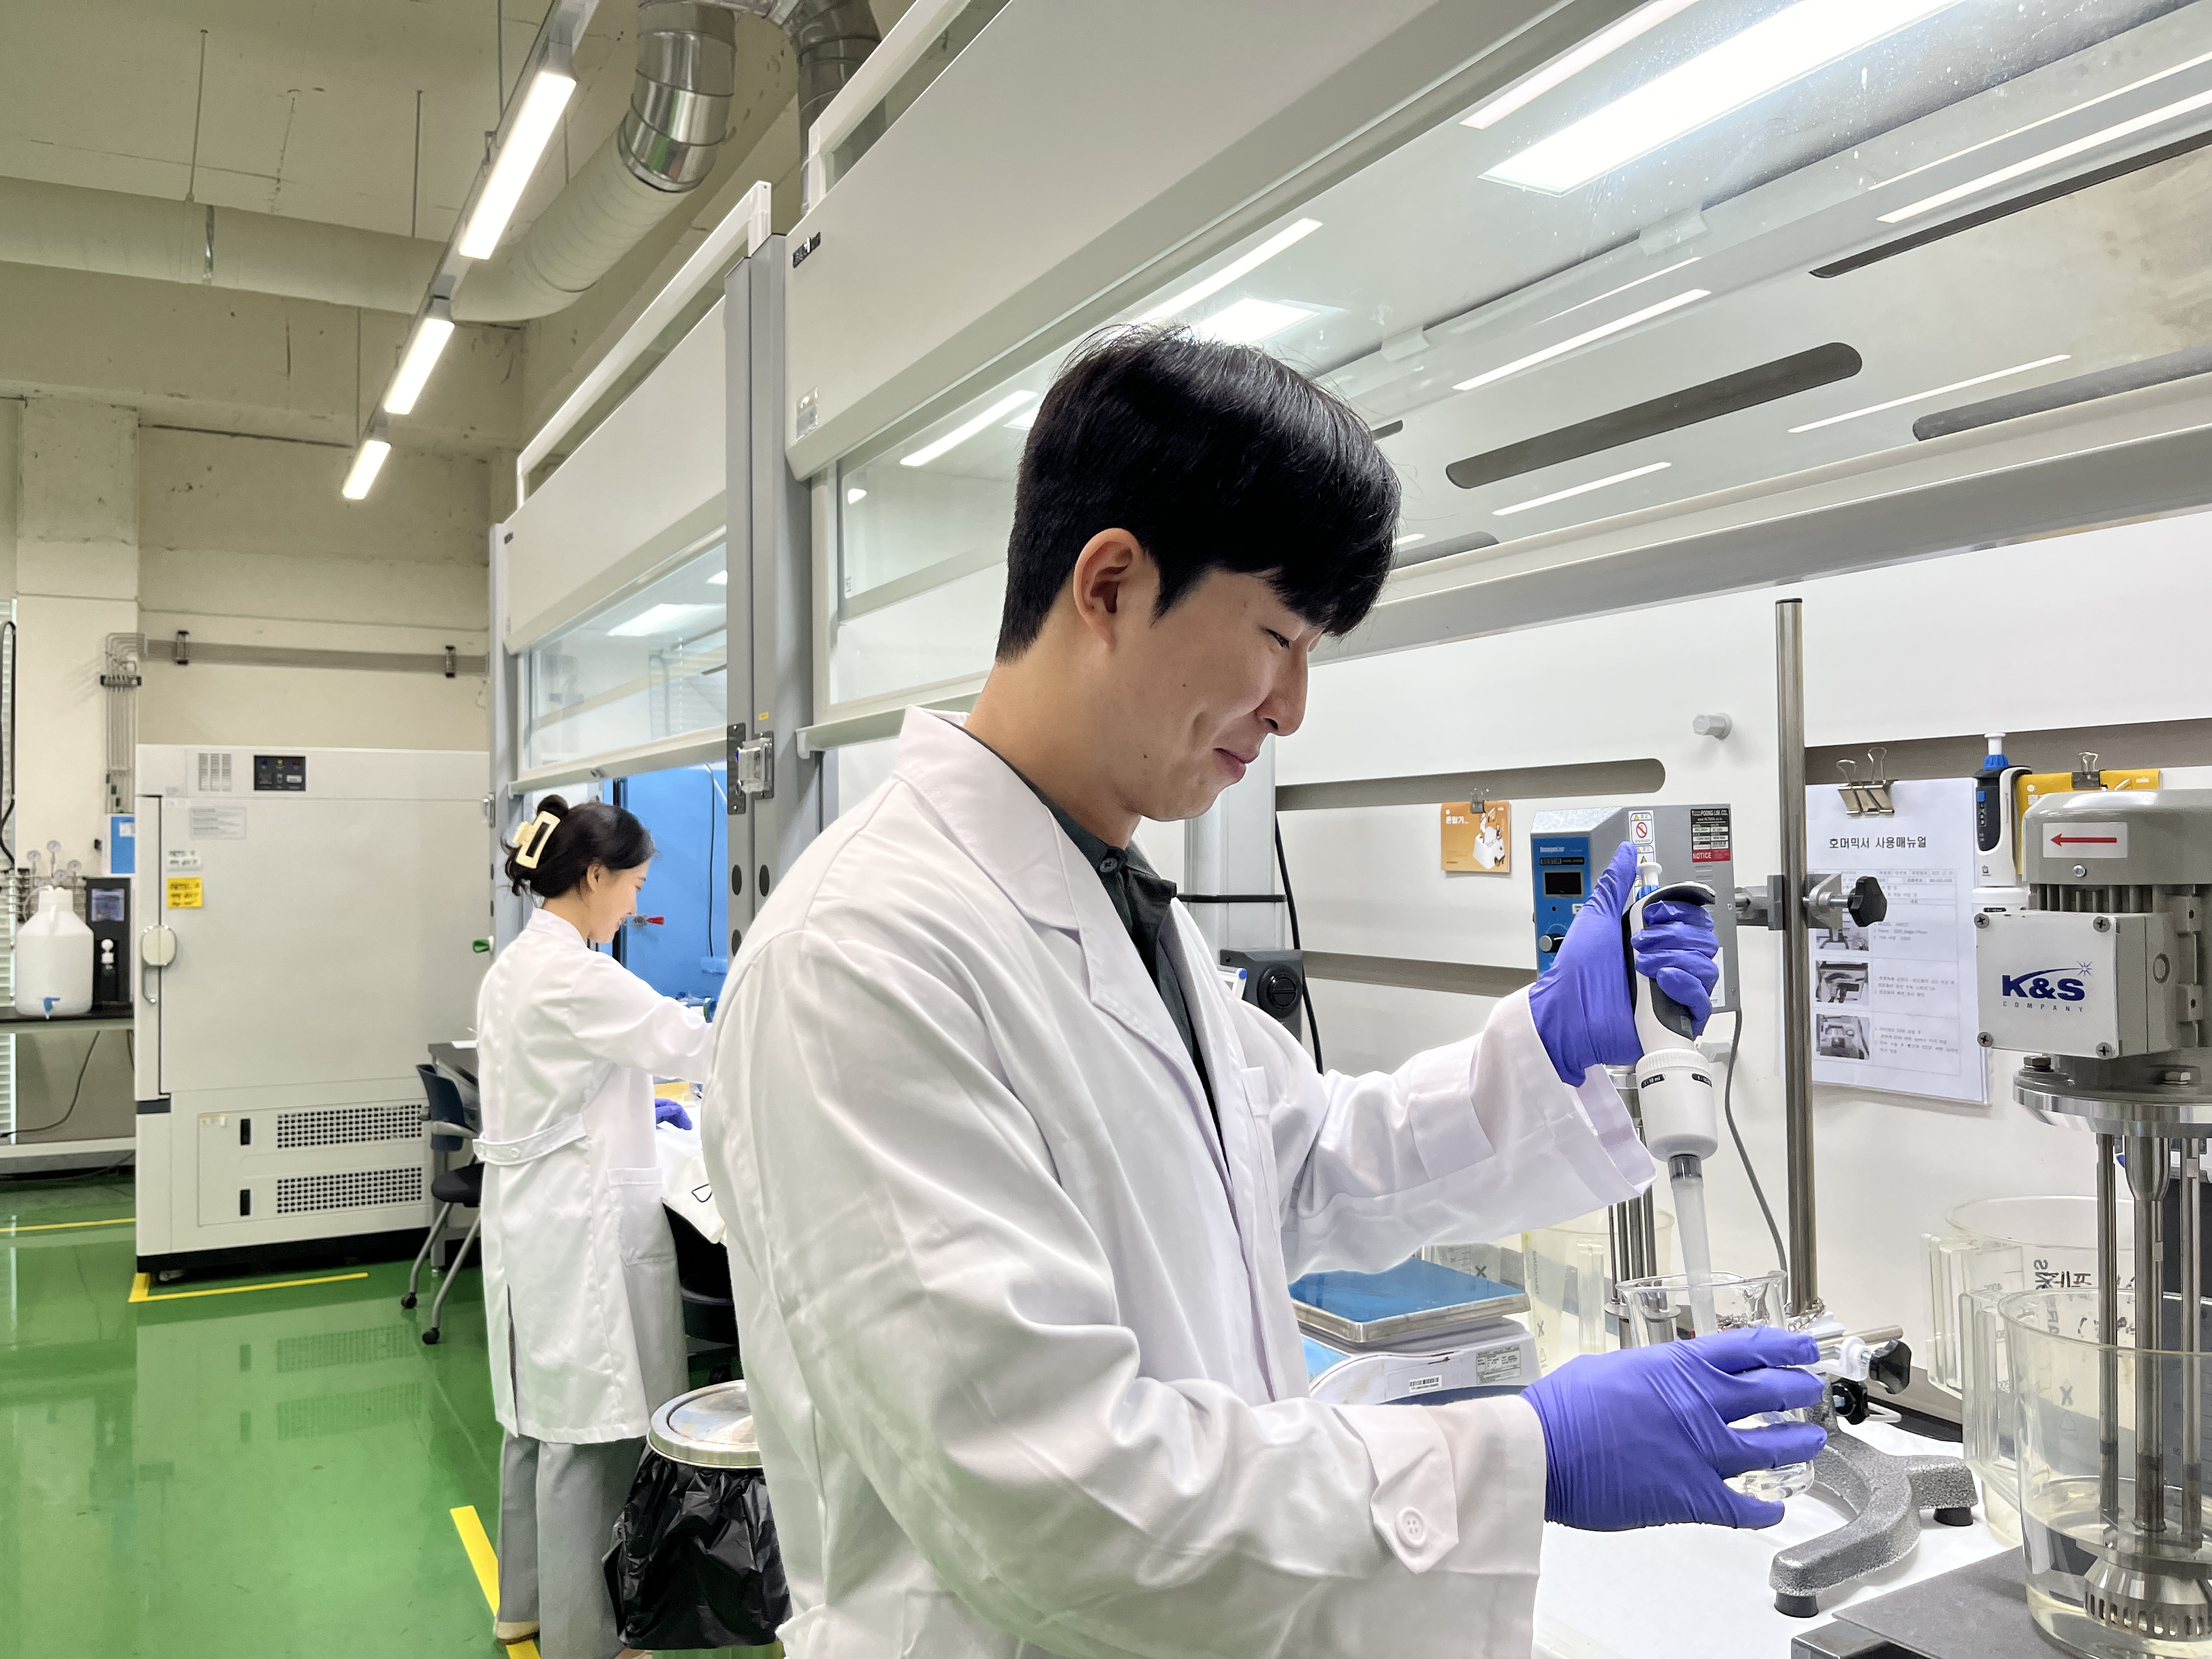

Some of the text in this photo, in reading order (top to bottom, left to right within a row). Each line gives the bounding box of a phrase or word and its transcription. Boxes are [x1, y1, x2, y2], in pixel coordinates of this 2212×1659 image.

[1829, 836, 1927, 849] 호머믹서 사용매뉴얼
[2002, 975, 2085, 1001] K&S
[2003, 1001, 2083, 1013] COMPANY
